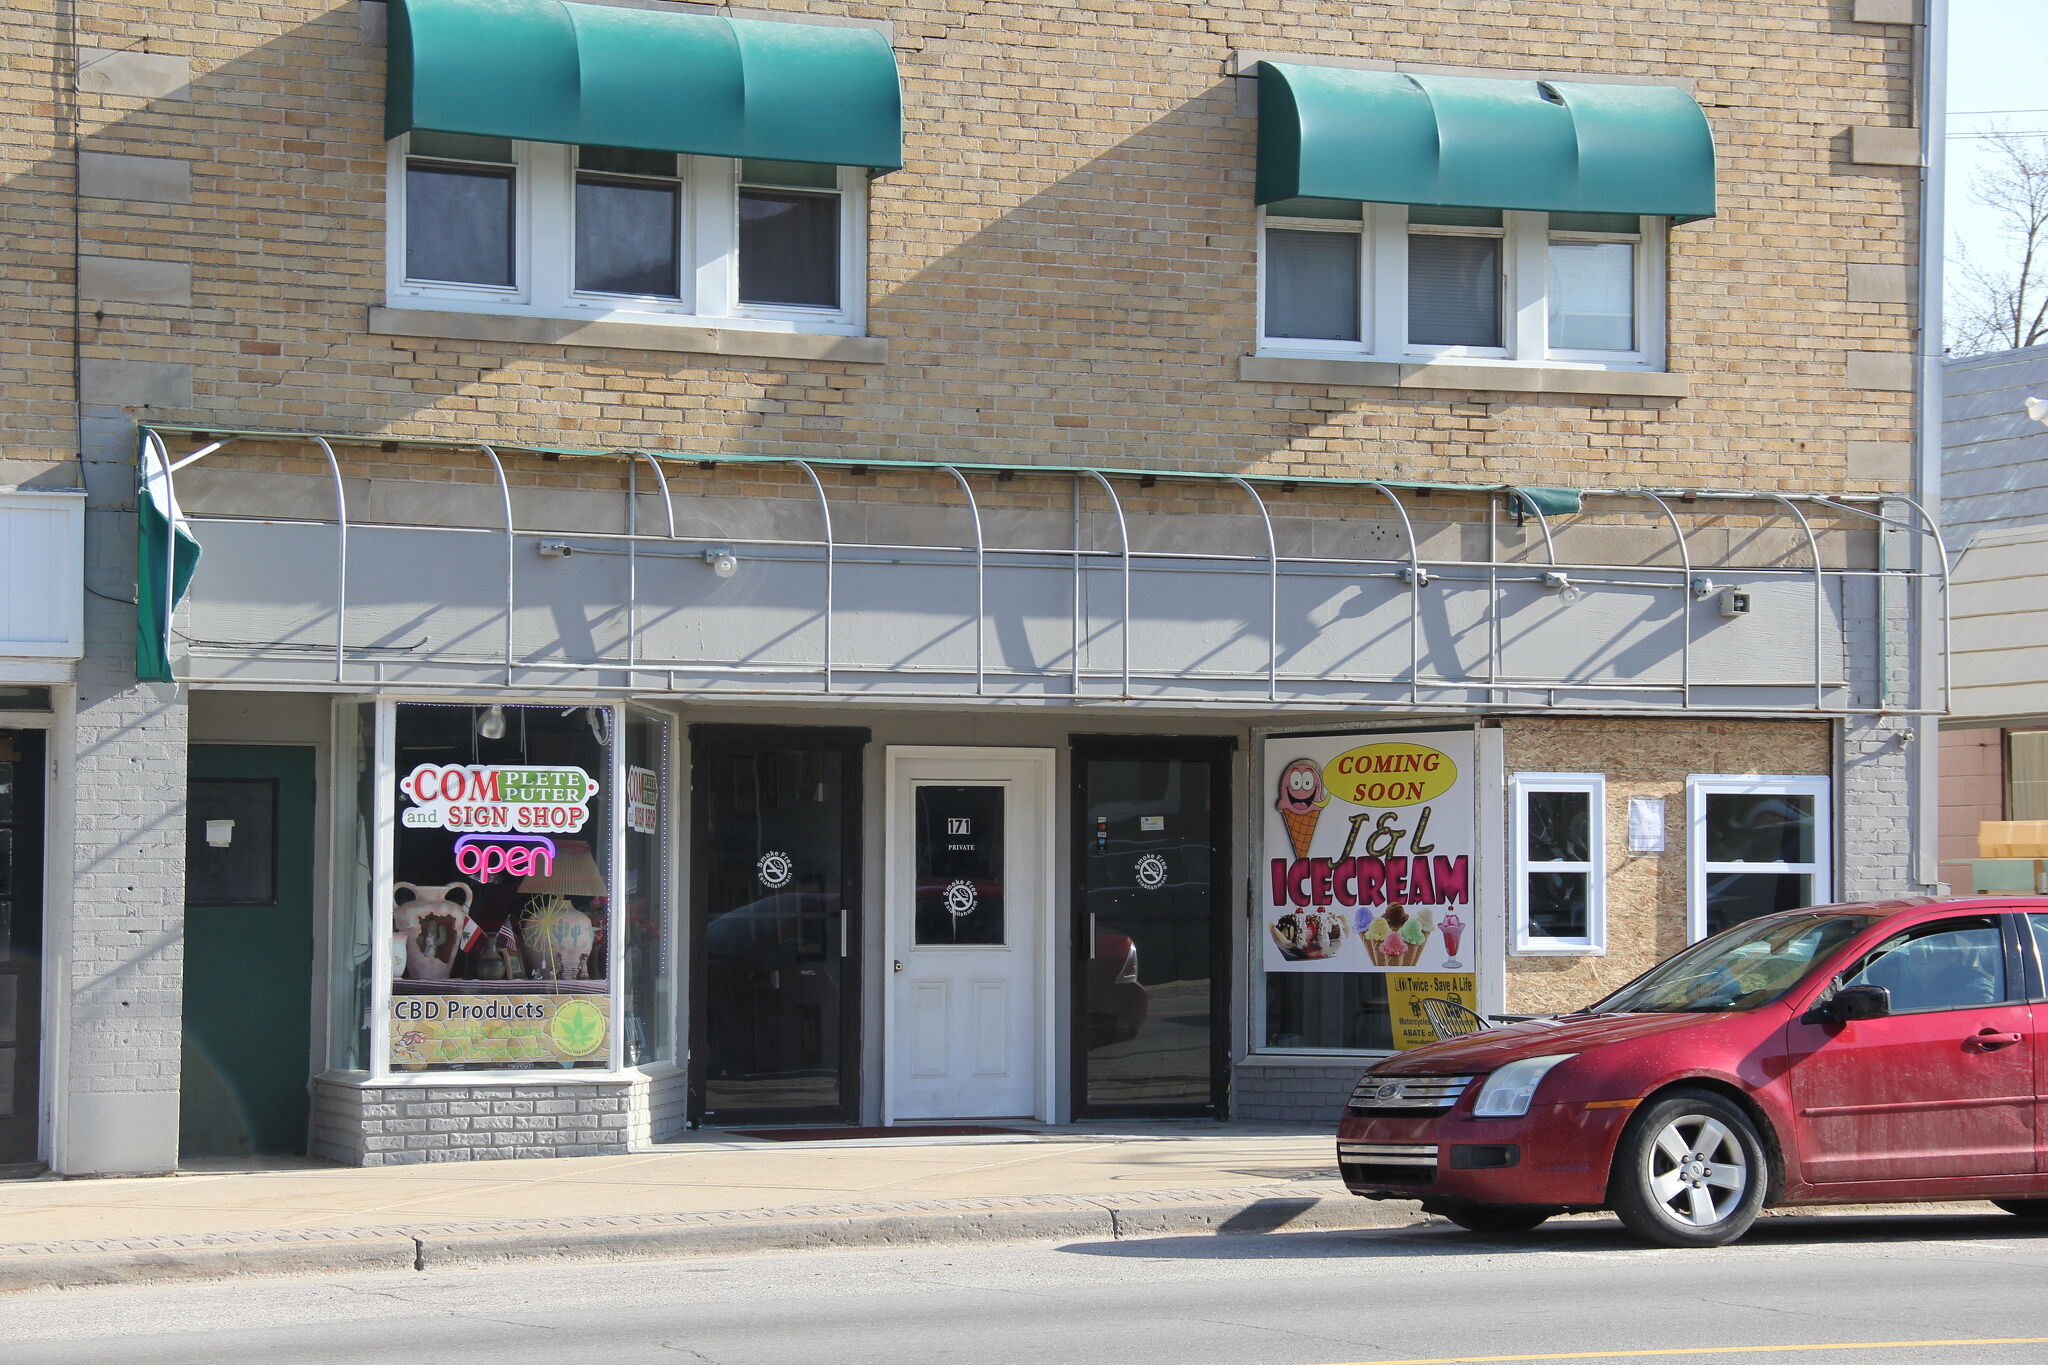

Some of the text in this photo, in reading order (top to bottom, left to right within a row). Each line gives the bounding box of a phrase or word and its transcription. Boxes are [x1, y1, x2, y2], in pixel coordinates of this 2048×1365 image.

[1338, 753, 1440, 774] COMING
[505, 772, 580, 786] PLETE
[507, 788, 580, 801] PUTER
[1353, 781, 1425, 801] SOON
[407, 806, 584, 827] and SIGN SHOP
[948, 819, 970, 834] 171
[456, 845, 553, 883] open
[757, 850, 793, 868] Smoke Free
[1134, 853, 1168, 870] Smoke Free
[758, 872, 793, 889] Establishment
[943, 879, 978, 897] Smoke Free
[1135, 874, 1168, 890] Establishment
[943, 900, 978, 917] Establishment
[1407, 977, 1429, 992] Twice
[1434, 977, 1450, 992] Save
[1452, 977, 1458, 992] A
[1459, 977, 1472, 992] Life
[394, 1000, 440, 1020] CBD
[447, 1000, 545, 1020] Products
